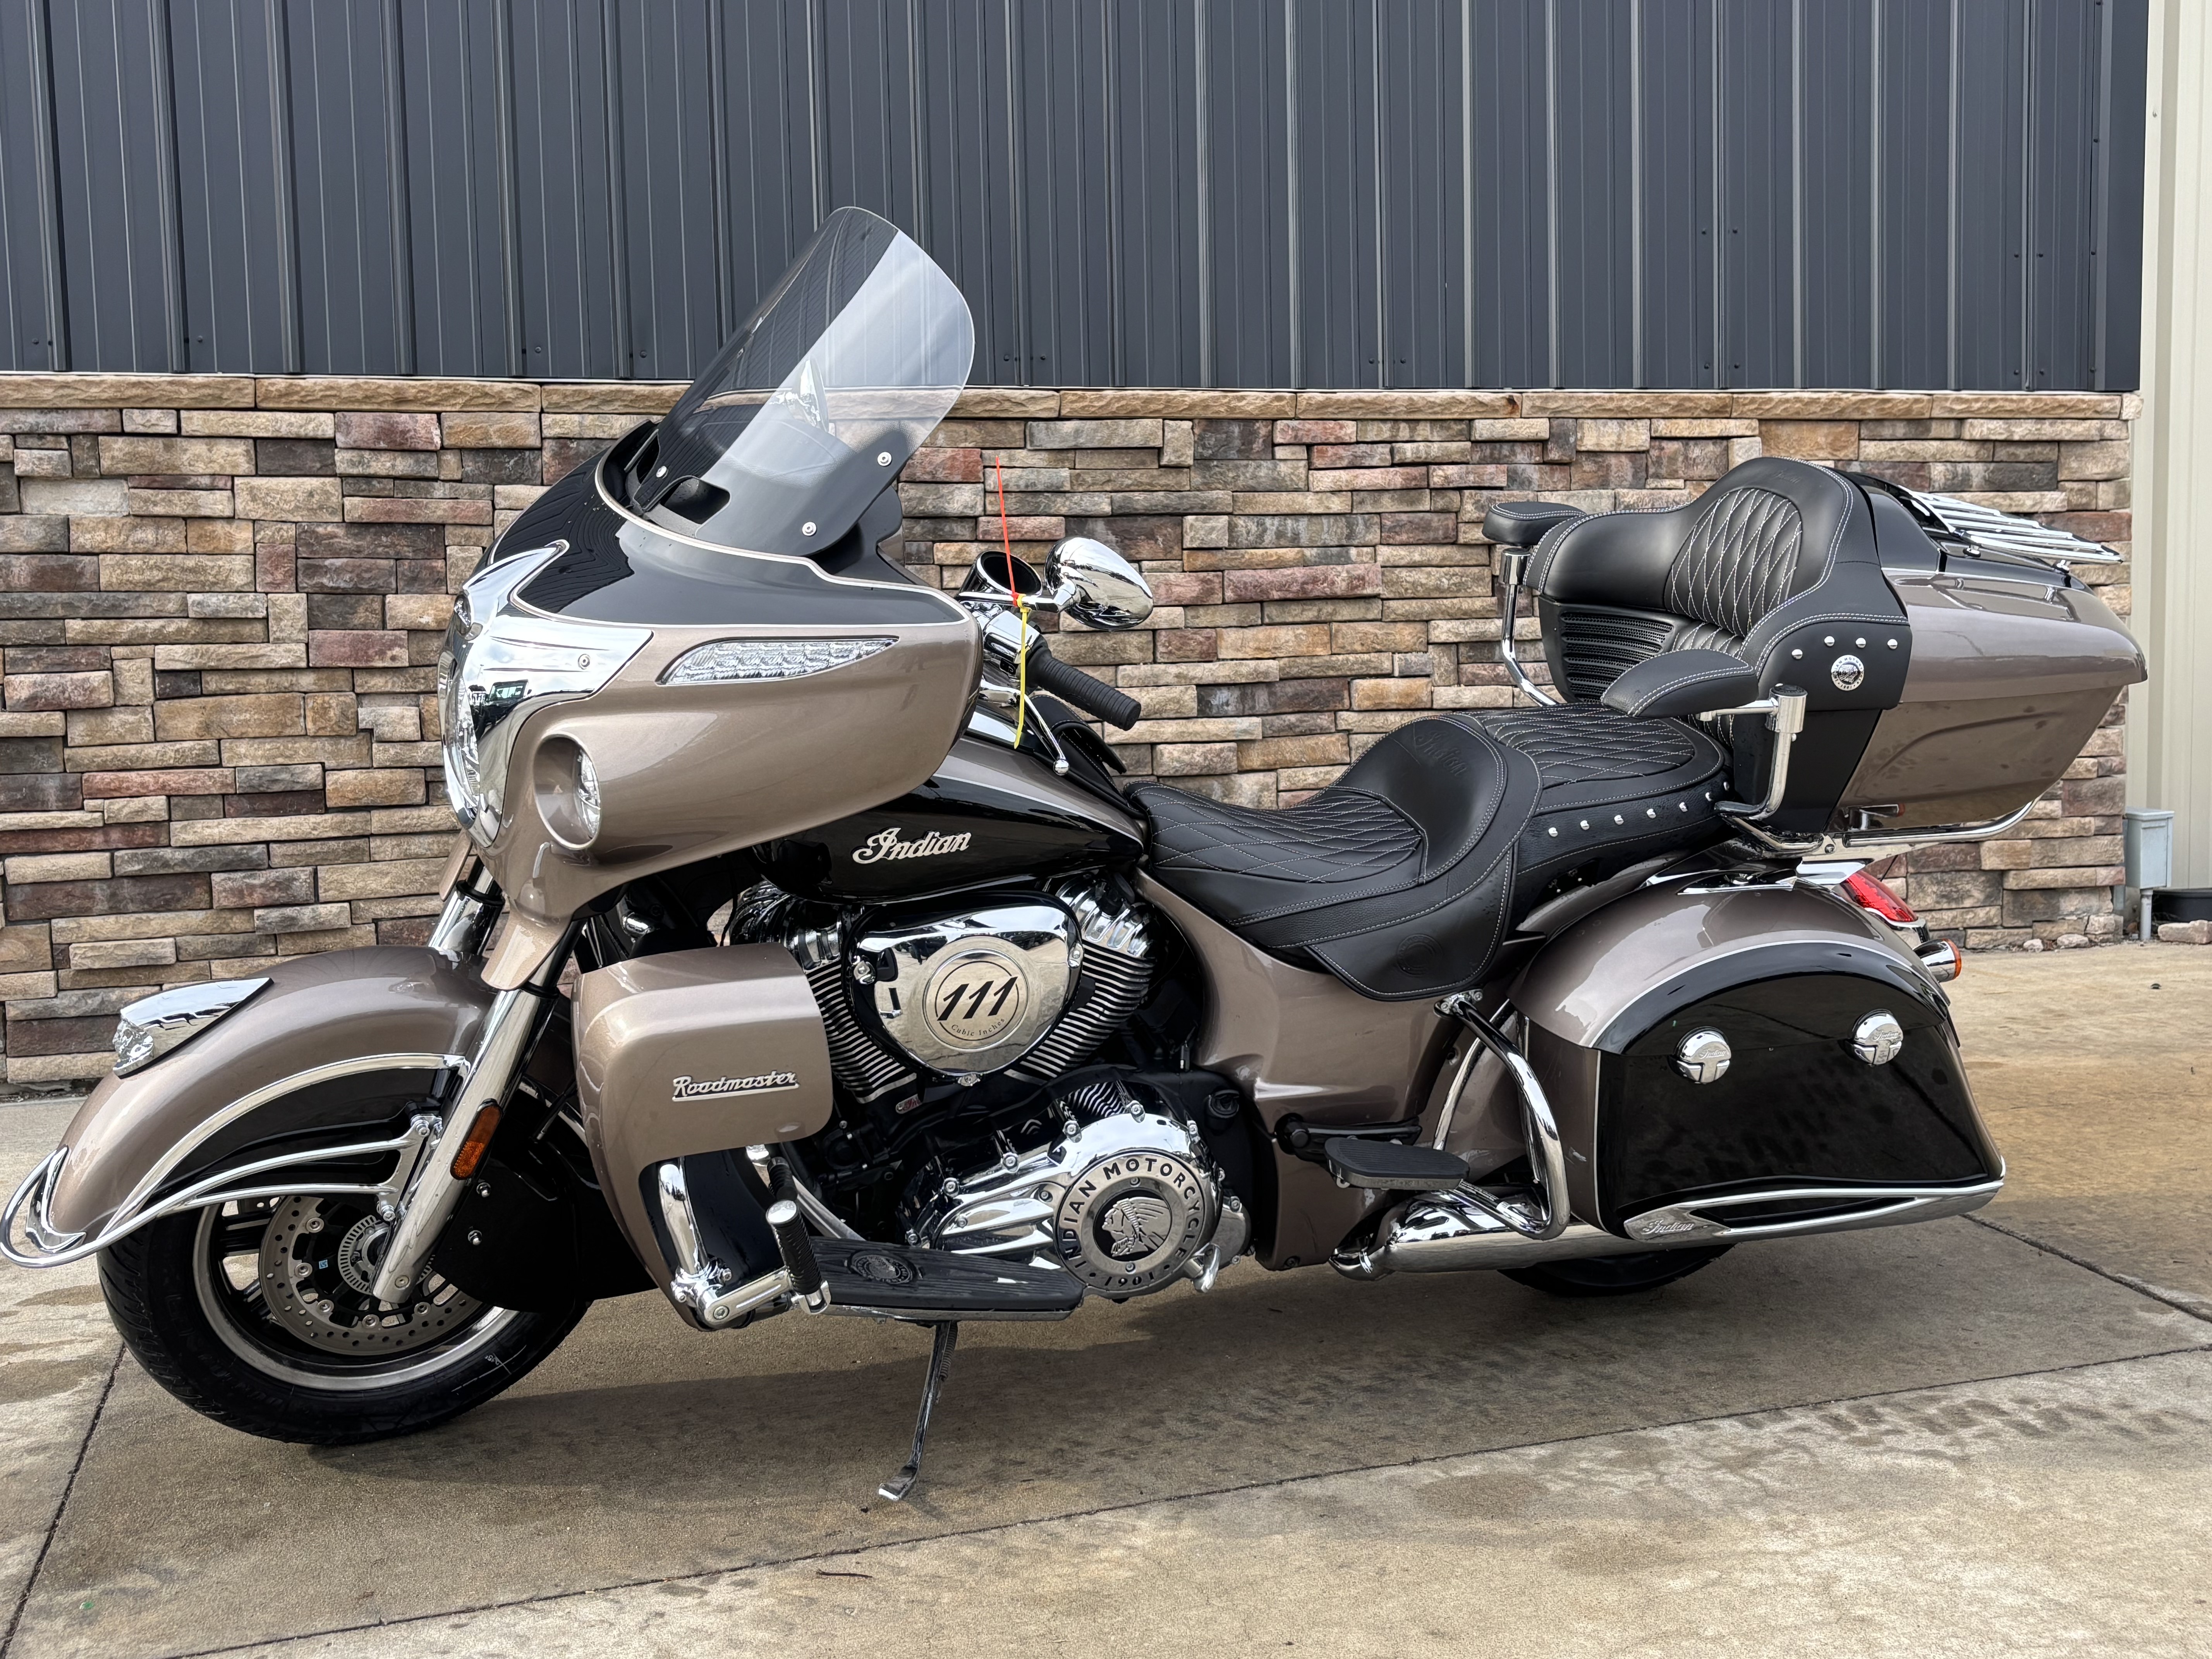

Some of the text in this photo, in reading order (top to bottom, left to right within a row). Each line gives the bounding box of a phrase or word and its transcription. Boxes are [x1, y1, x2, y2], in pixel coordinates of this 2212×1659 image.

[852, 827, 971, 864] Indian
[937, 976, 1018, 1021] 111
[951, 1018, 1005, 1036] Cubic Inches
[673, 1070, 797, 1097] Roadmaster
[1063, 1158, 1202, 1269] INDIAN MOTORCYCLE
[1641, 1219, 1695, 1235] Indian
[1104, 1272, 1155, 1286] 1901
